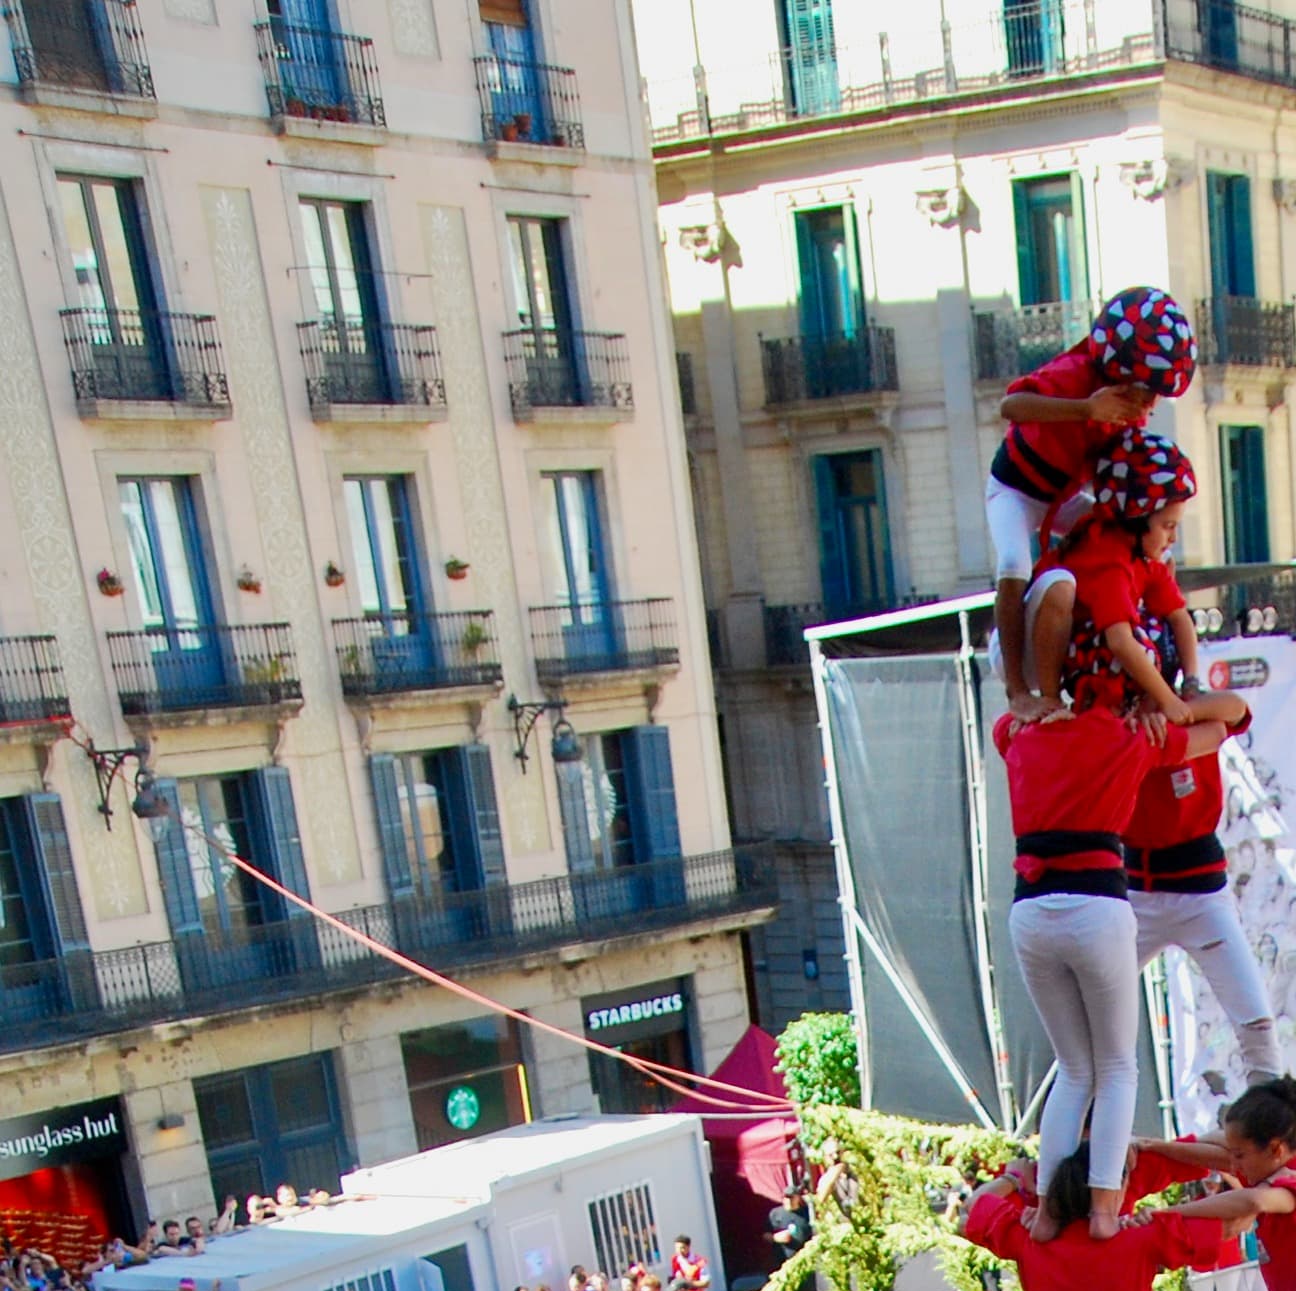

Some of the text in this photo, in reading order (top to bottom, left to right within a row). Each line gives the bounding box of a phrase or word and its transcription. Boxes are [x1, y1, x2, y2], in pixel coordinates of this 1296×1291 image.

[588, 993, 684, 1031] STARBUCKS
[0, 1112, 119, 1158] sunglass hut
